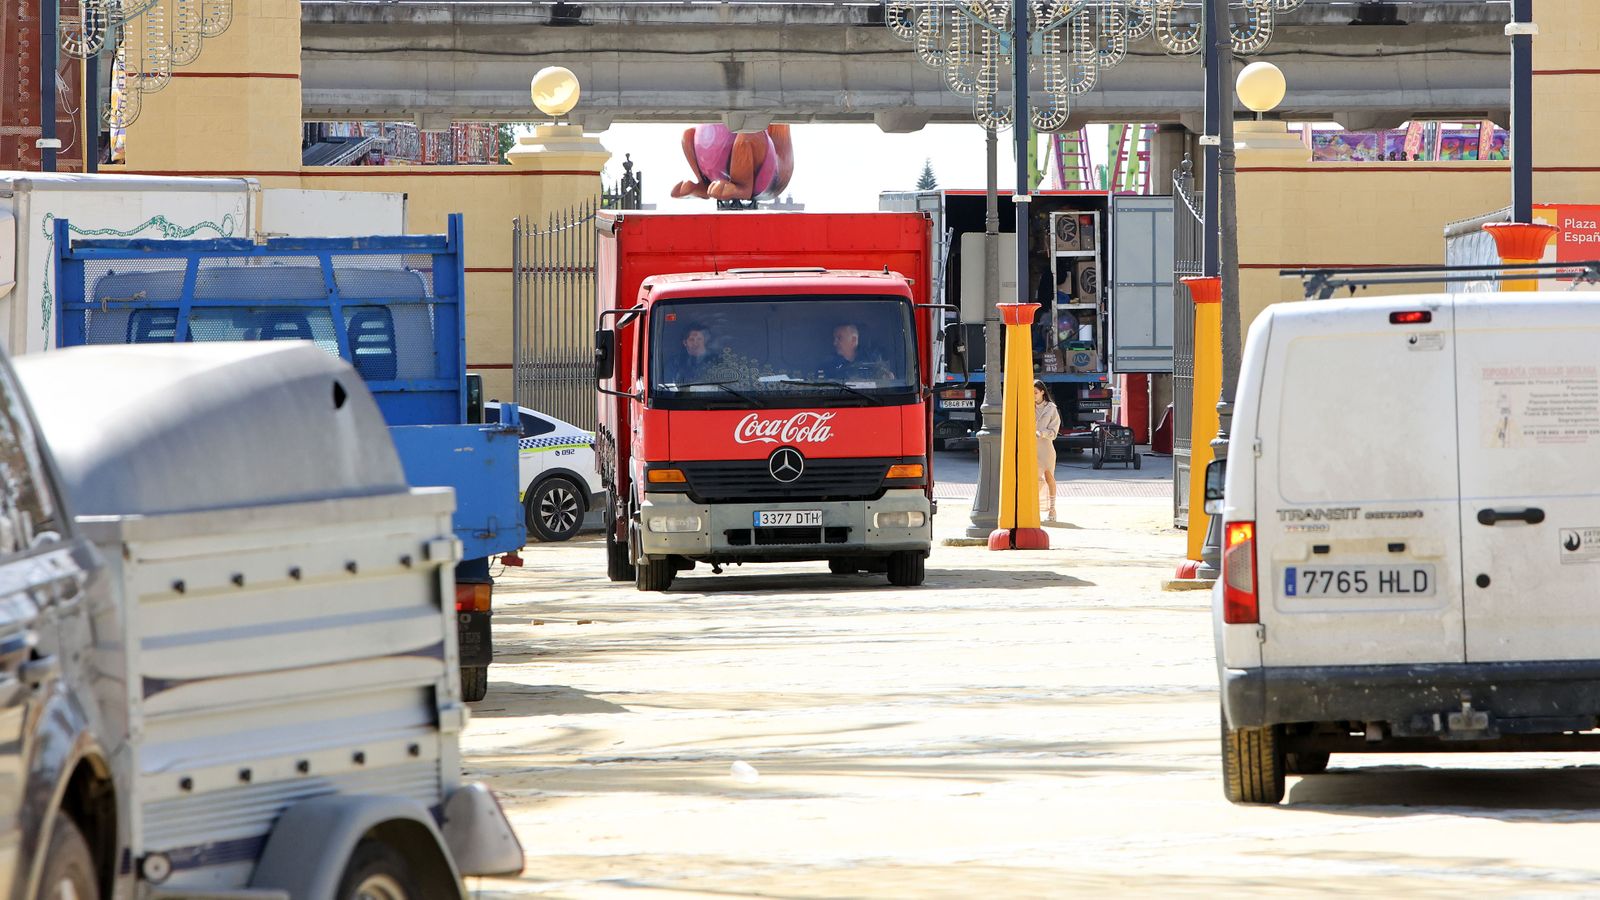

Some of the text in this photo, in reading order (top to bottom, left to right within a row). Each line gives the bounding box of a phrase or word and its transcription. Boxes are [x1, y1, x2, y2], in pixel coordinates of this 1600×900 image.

[1564, 218, 1597, 229] Plaza
[734, 411, 837, 444] Coca-Cola
[561, 448, 575, 456] 092
[762, 512, 819, 525] 3377 DTH
[1276, 508, 1361, 521] TRANSIT
[1303, 570, 1368, 593] 7765
[1379, 570, 1428, 593] HLD
